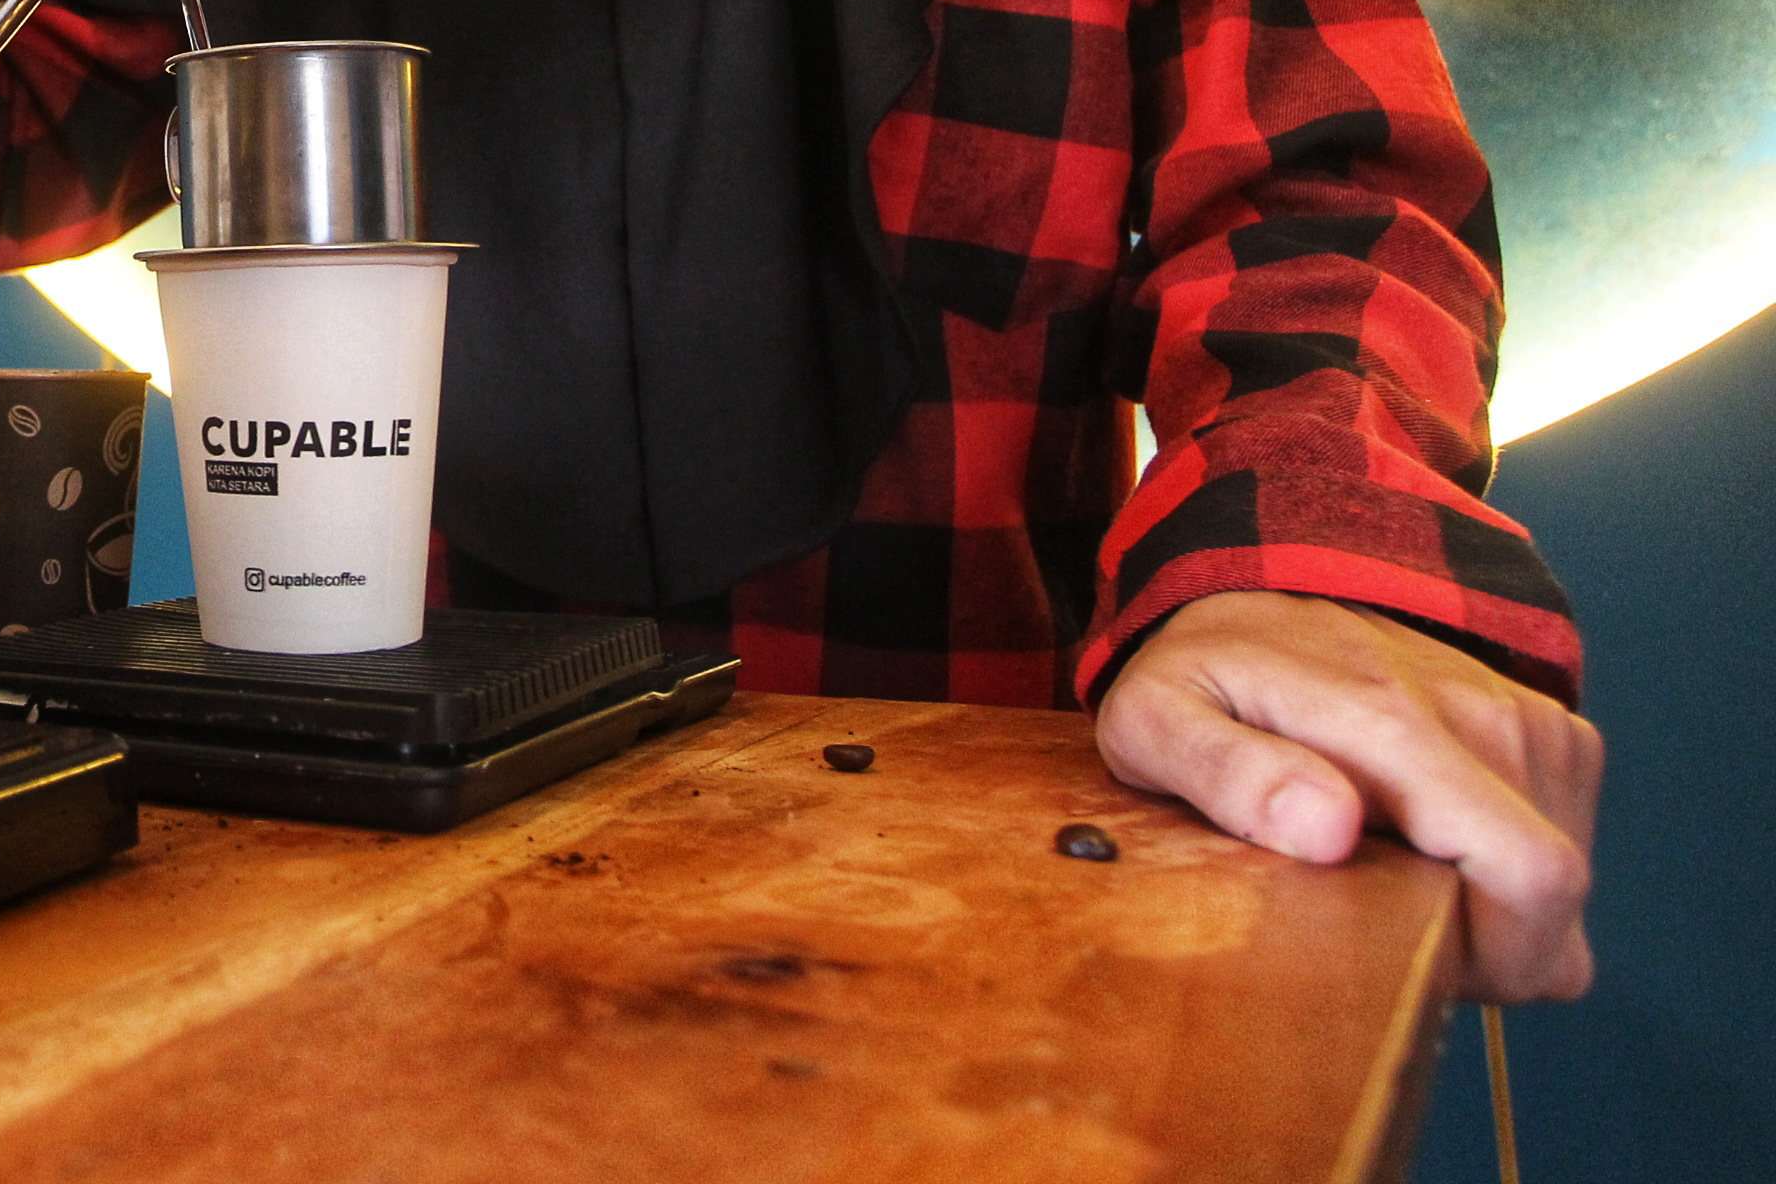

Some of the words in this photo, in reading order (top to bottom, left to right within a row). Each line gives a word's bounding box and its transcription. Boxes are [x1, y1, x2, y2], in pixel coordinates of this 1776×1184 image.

[201, 416, 412, 458] CUPABLE
[207, 464, 246, 476] KARENA
[247, 466, 275, 477] KOPI
[228, 480, 271, 493] SETARA
[268, 572, 367, 590] cupablecoffee
